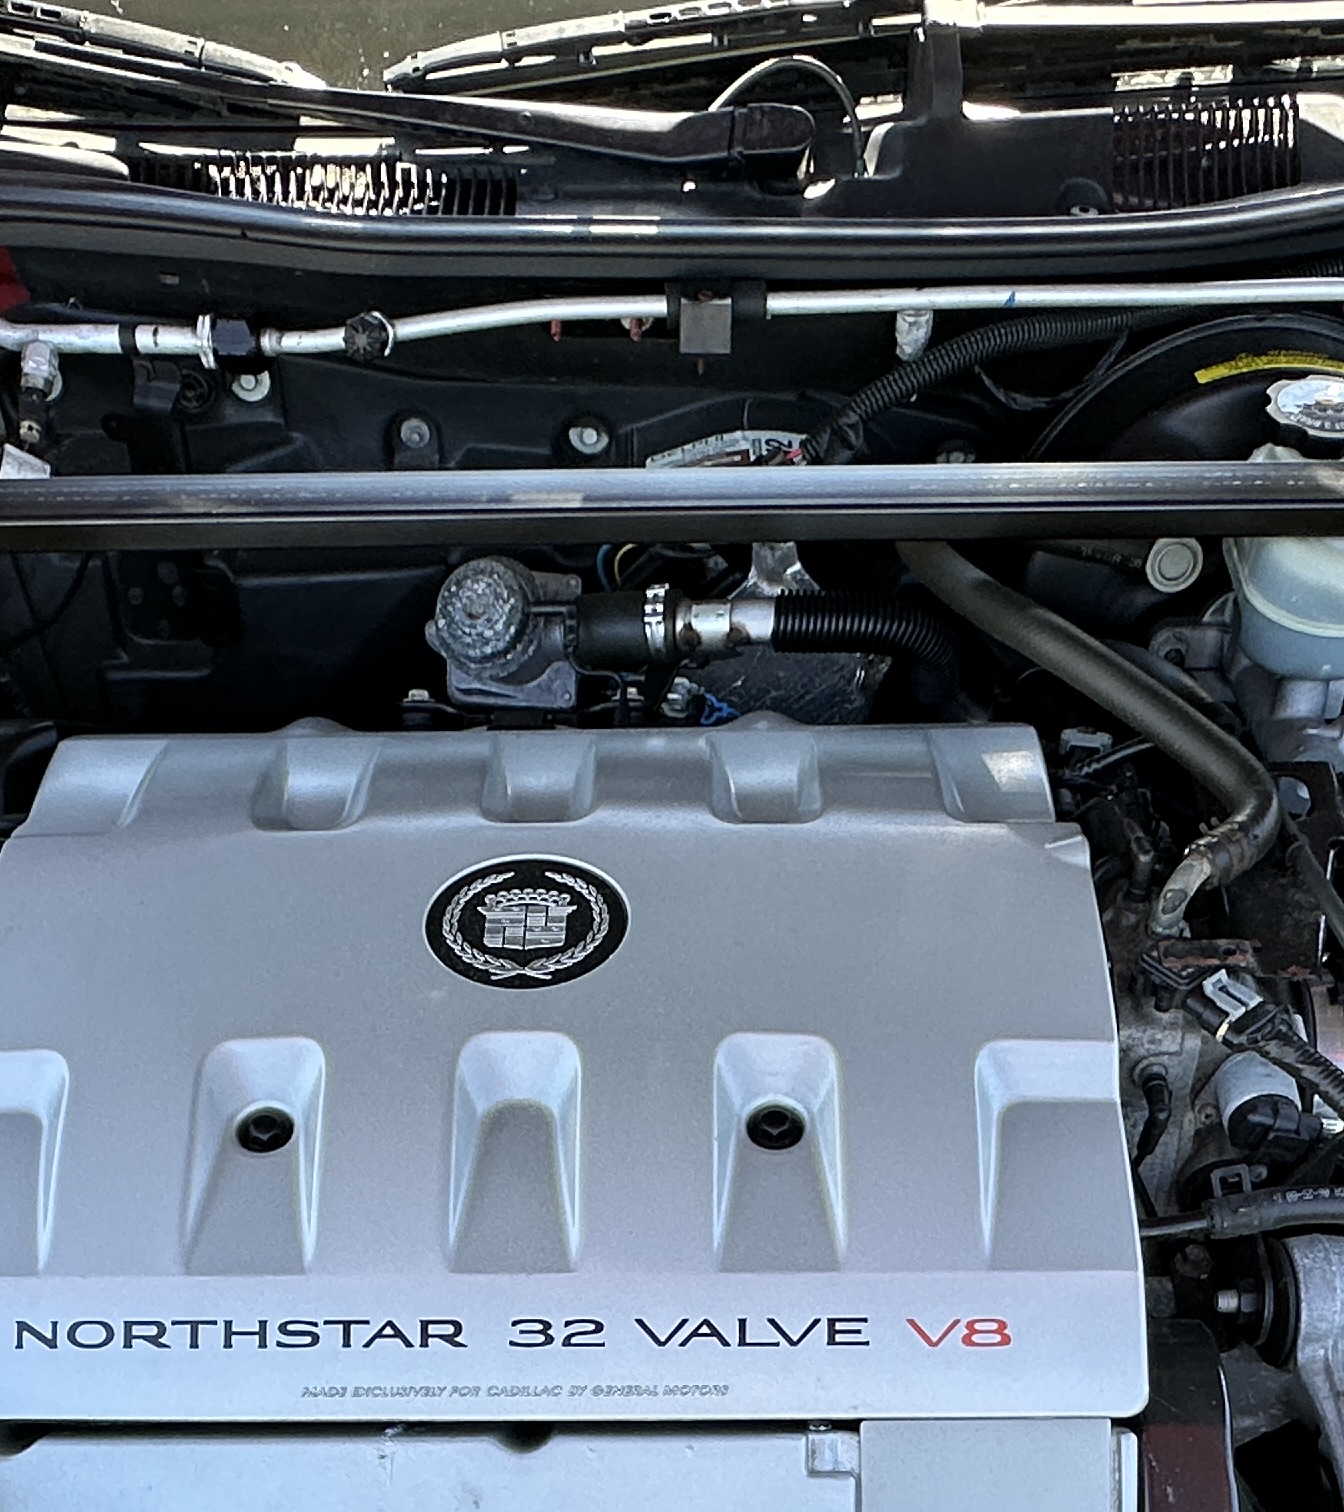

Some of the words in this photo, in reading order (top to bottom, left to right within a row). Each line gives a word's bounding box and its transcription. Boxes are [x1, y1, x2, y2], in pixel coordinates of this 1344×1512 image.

[14, 1319, 468, 1351] NORTHSTAR
[508, 1317, 606, 1349] 32
[634, 1317, 871, 1348] VALVE
[905, 1317, 1013, 1349] V8
[301, 1386, 348, 1398] MADE
[351, 1386, 448, 1398] EXCLUSIVELY
[449, 1386, 482, 1397] FOR
[486, 1385, 564, 1397] CADILLAC
[567, 1385, 588, 1397] BY
[590, 1384, 659, 1397] GENERAL
[662, 1384, 730, 1397] MOTORS
